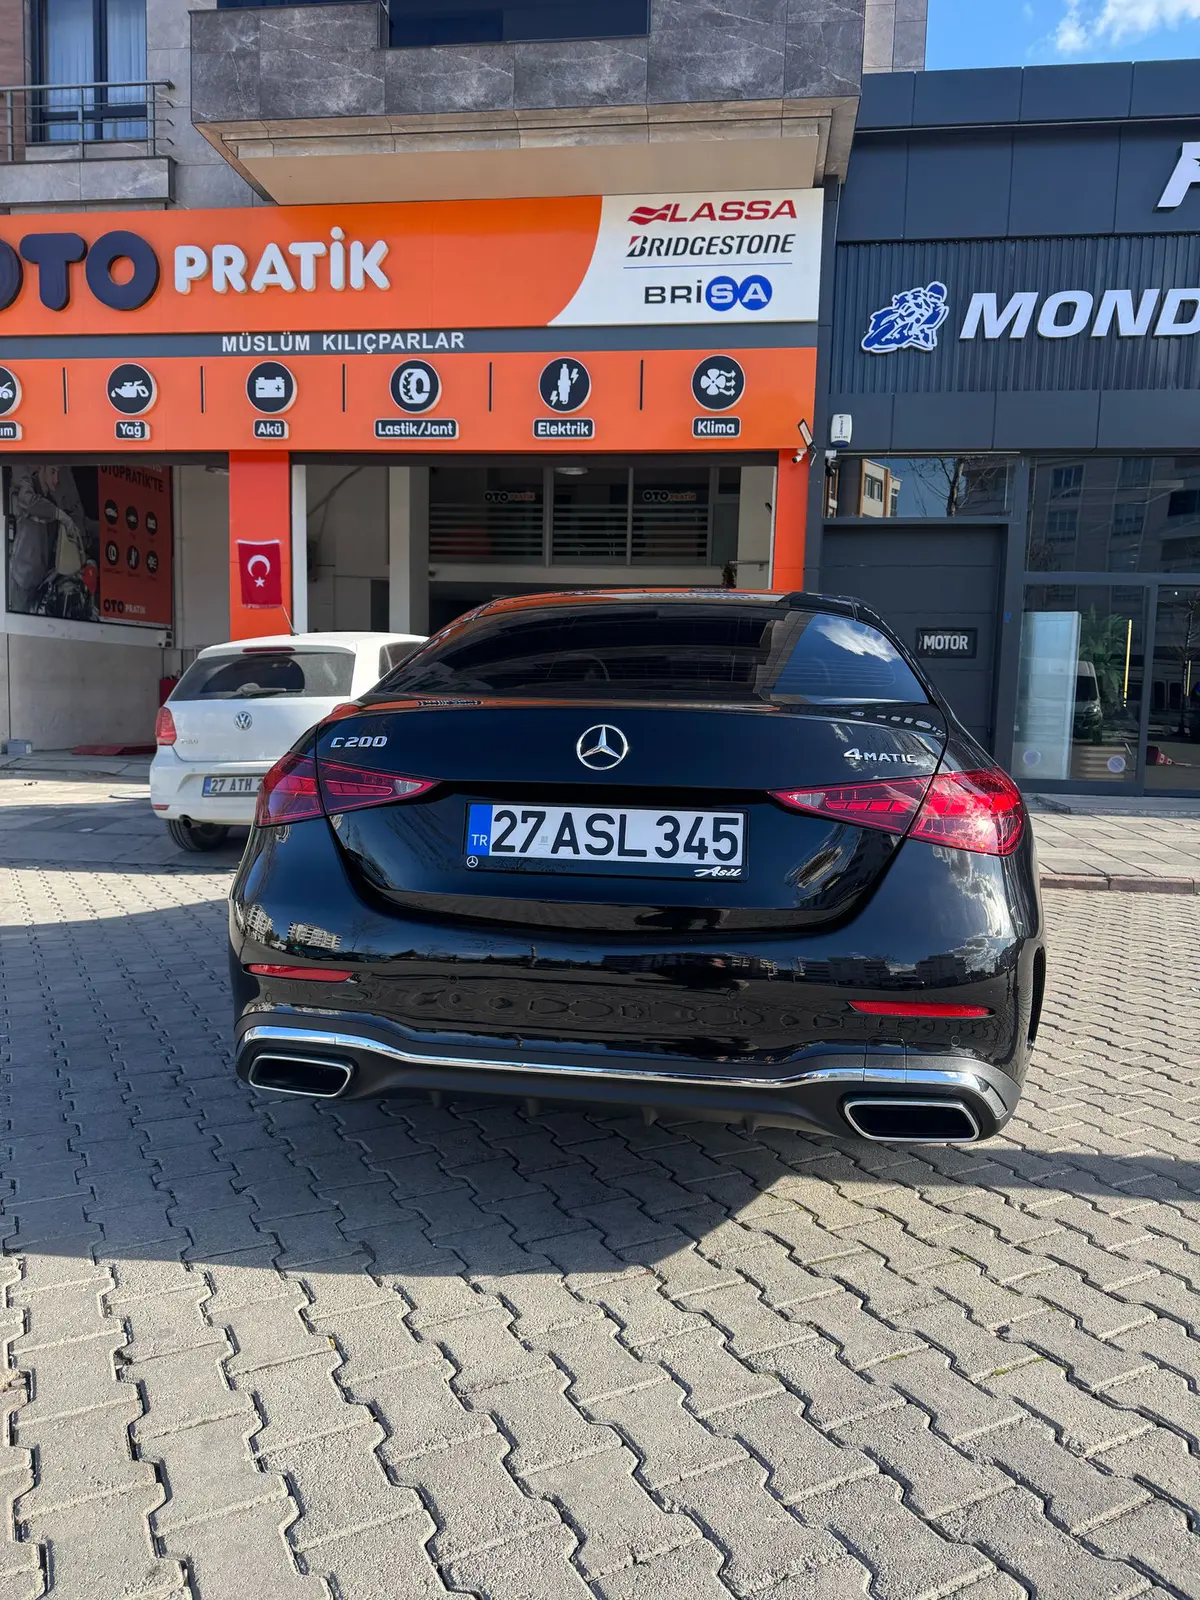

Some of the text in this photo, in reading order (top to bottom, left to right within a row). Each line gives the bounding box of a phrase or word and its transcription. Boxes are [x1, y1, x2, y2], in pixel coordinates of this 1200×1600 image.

[668, 200, 797, 222] LASSA
[626, 234, 796, 257] BRIDGESTONE
[174, 226, 390, 294] PRATİK
[222, 332, 465, 353] MÜSLÜM KILIÇPARLAR
[119, 422, 142, 437] Yağ
[257, 423, 282, 435] Akü
[378, 422, 453, 435] Lastik/Jant
[537, 422, 589, 435] Elektrik
[697, 421, 735, 434] Klima
[643, 490, 669, 502] OTO
[103, 599, 125, 613] OTO
[923, 635, 969, 650] MOTOR
[843, 747, 918, 764] 4MATIC
[211, 779, 226, 792] 27
[229, 779, 253, 791] ATH
[471, 834, 488, 846] TR
[491, 809, 740, 862] 27 ASL 345
